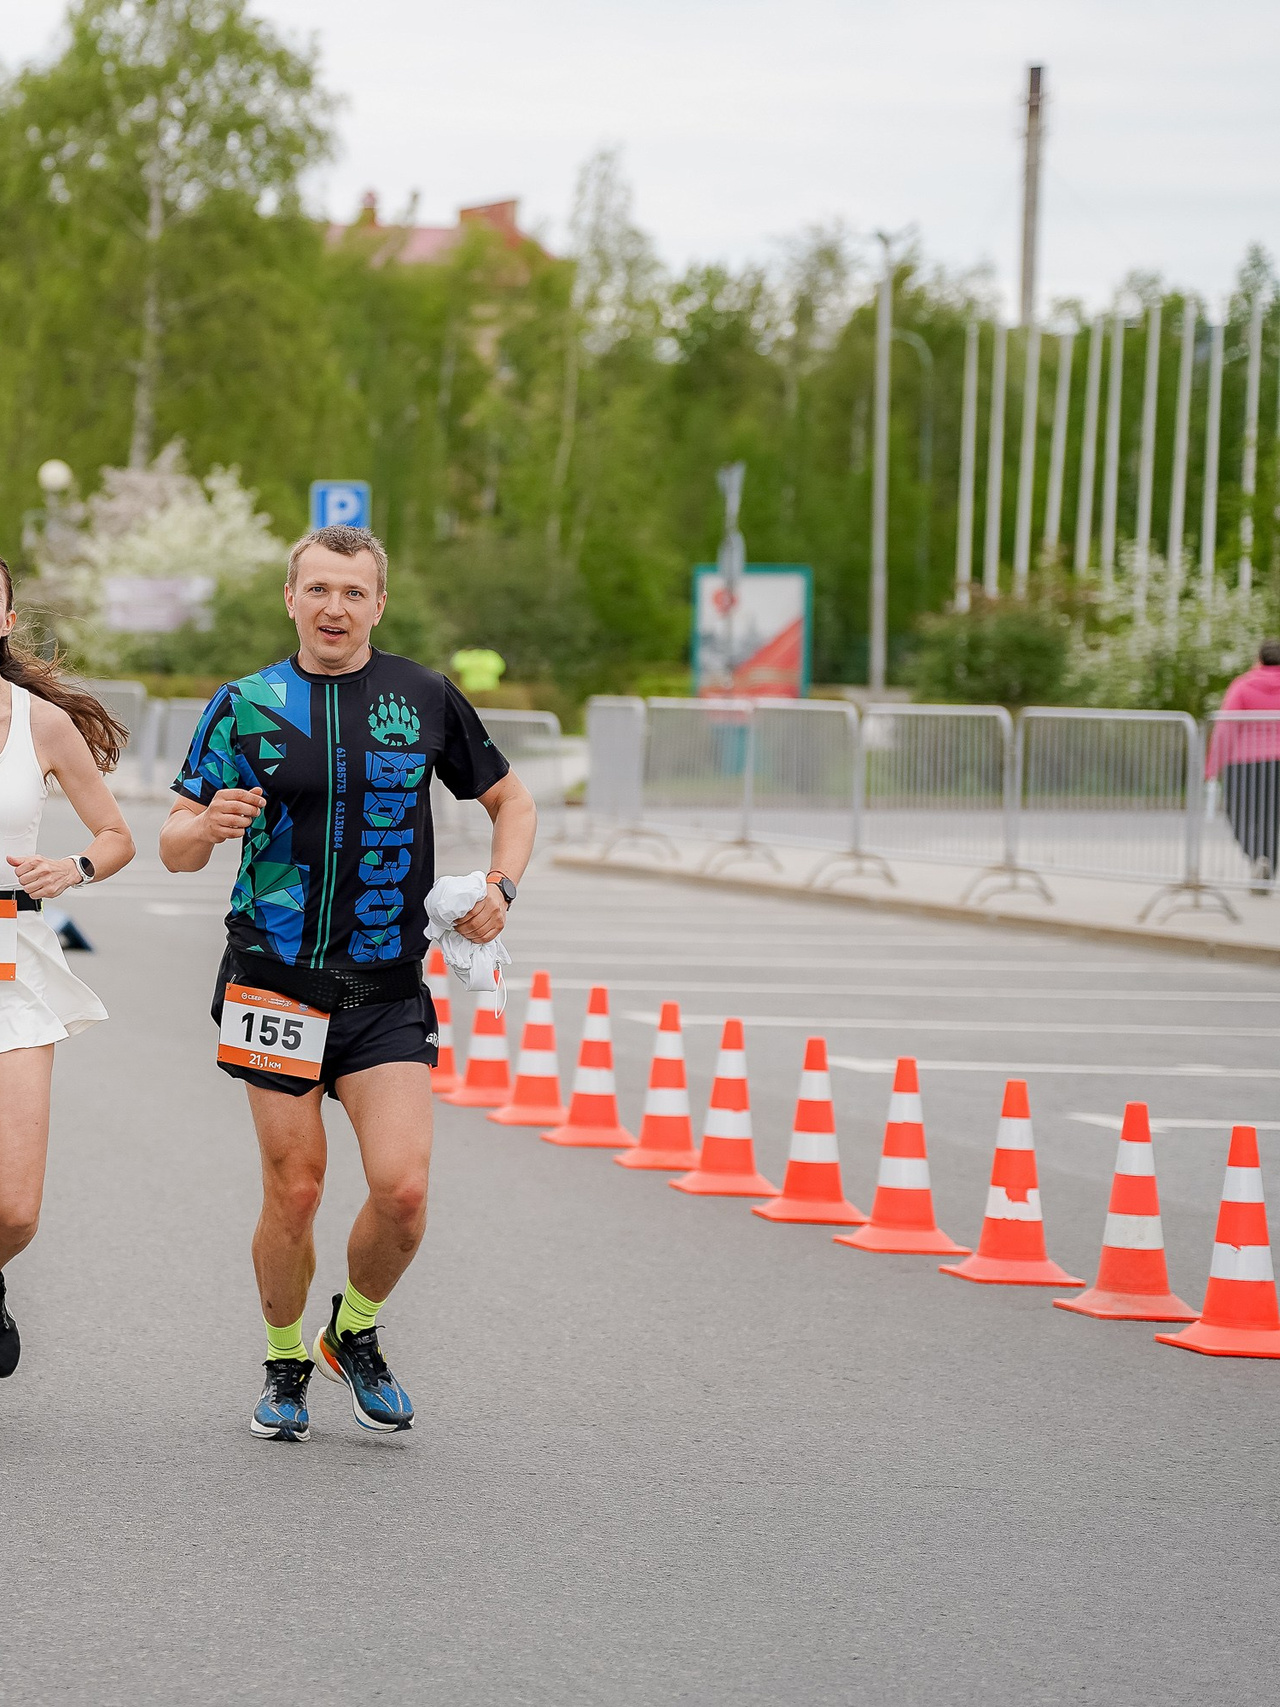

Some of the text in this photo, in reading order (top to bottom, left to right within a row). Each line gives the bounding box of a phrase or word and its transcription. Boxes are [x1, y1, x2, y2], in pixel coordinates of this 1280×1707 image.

[327, 487, 360, 527] P
[333, 747, 346, 849] 61.285731 63.131884
[348, 751, 426, 963] ВЫЗОВ
[241, 1012, 304, 1051] 155
